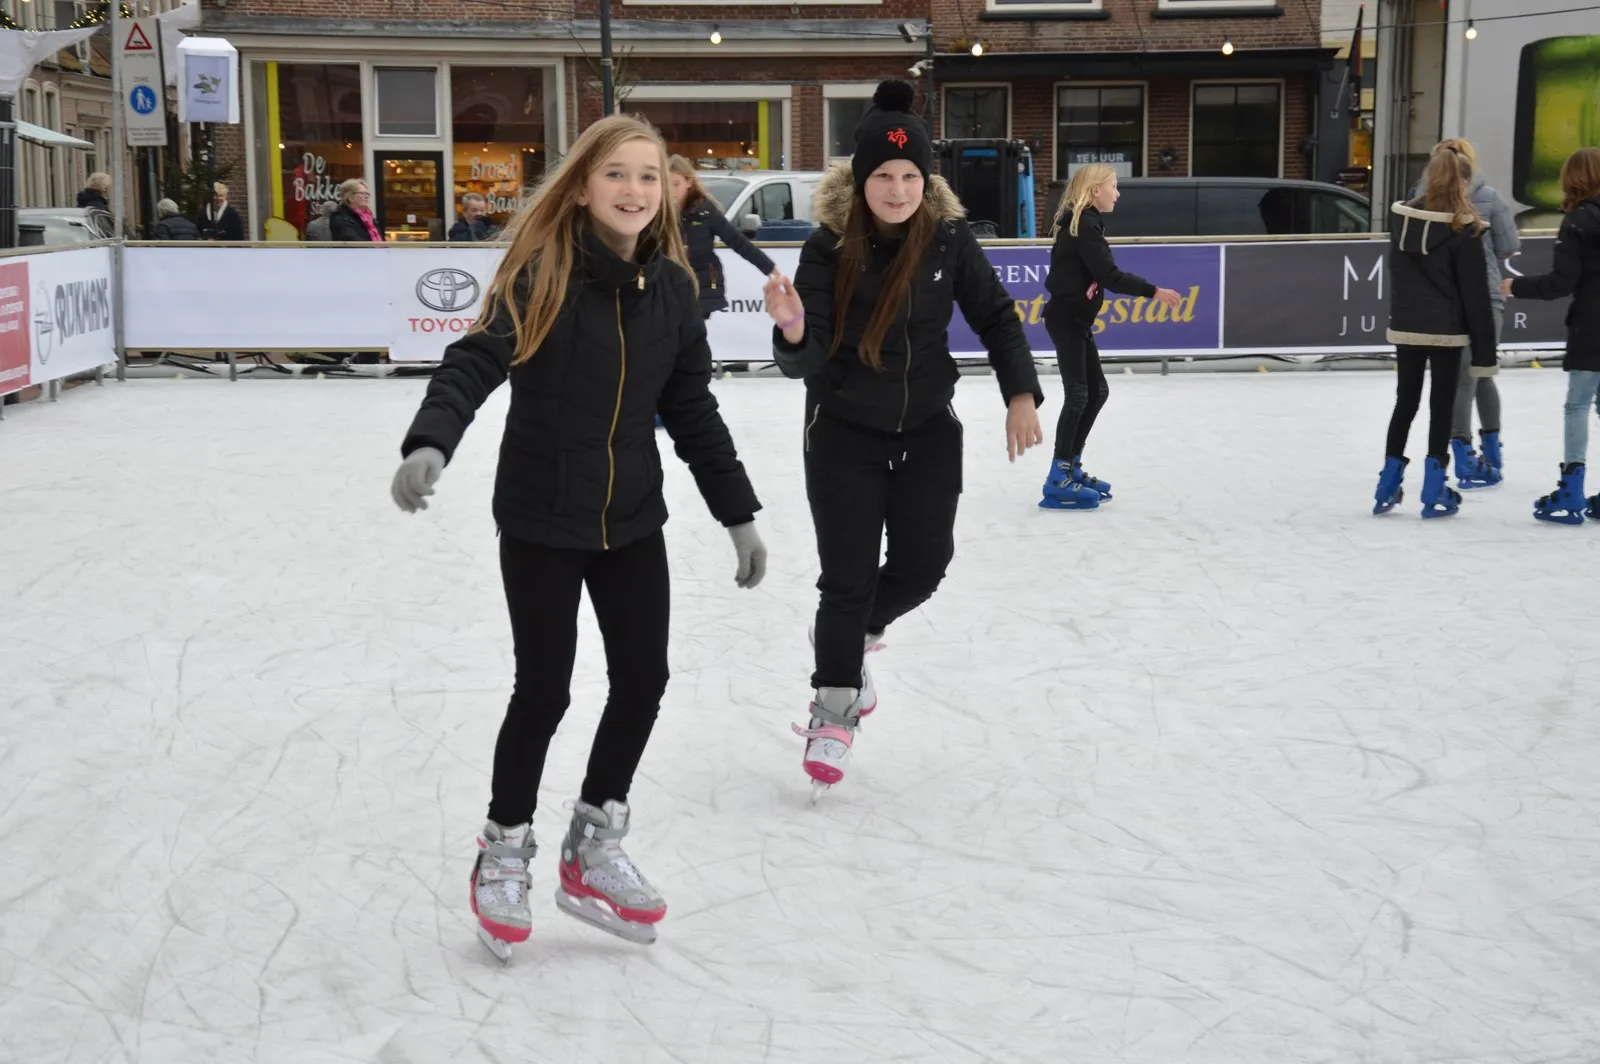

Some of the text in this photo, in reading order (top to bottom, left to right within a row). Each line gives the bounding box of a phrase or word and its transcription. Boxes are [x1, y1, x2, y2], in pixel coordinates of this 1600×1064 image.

[303, 152, 327, 174] De
[471, 154, 518, 180] Brood
[293, 175, 342, 202] Bakke
[408, 317, 475, 333] TOYOT
